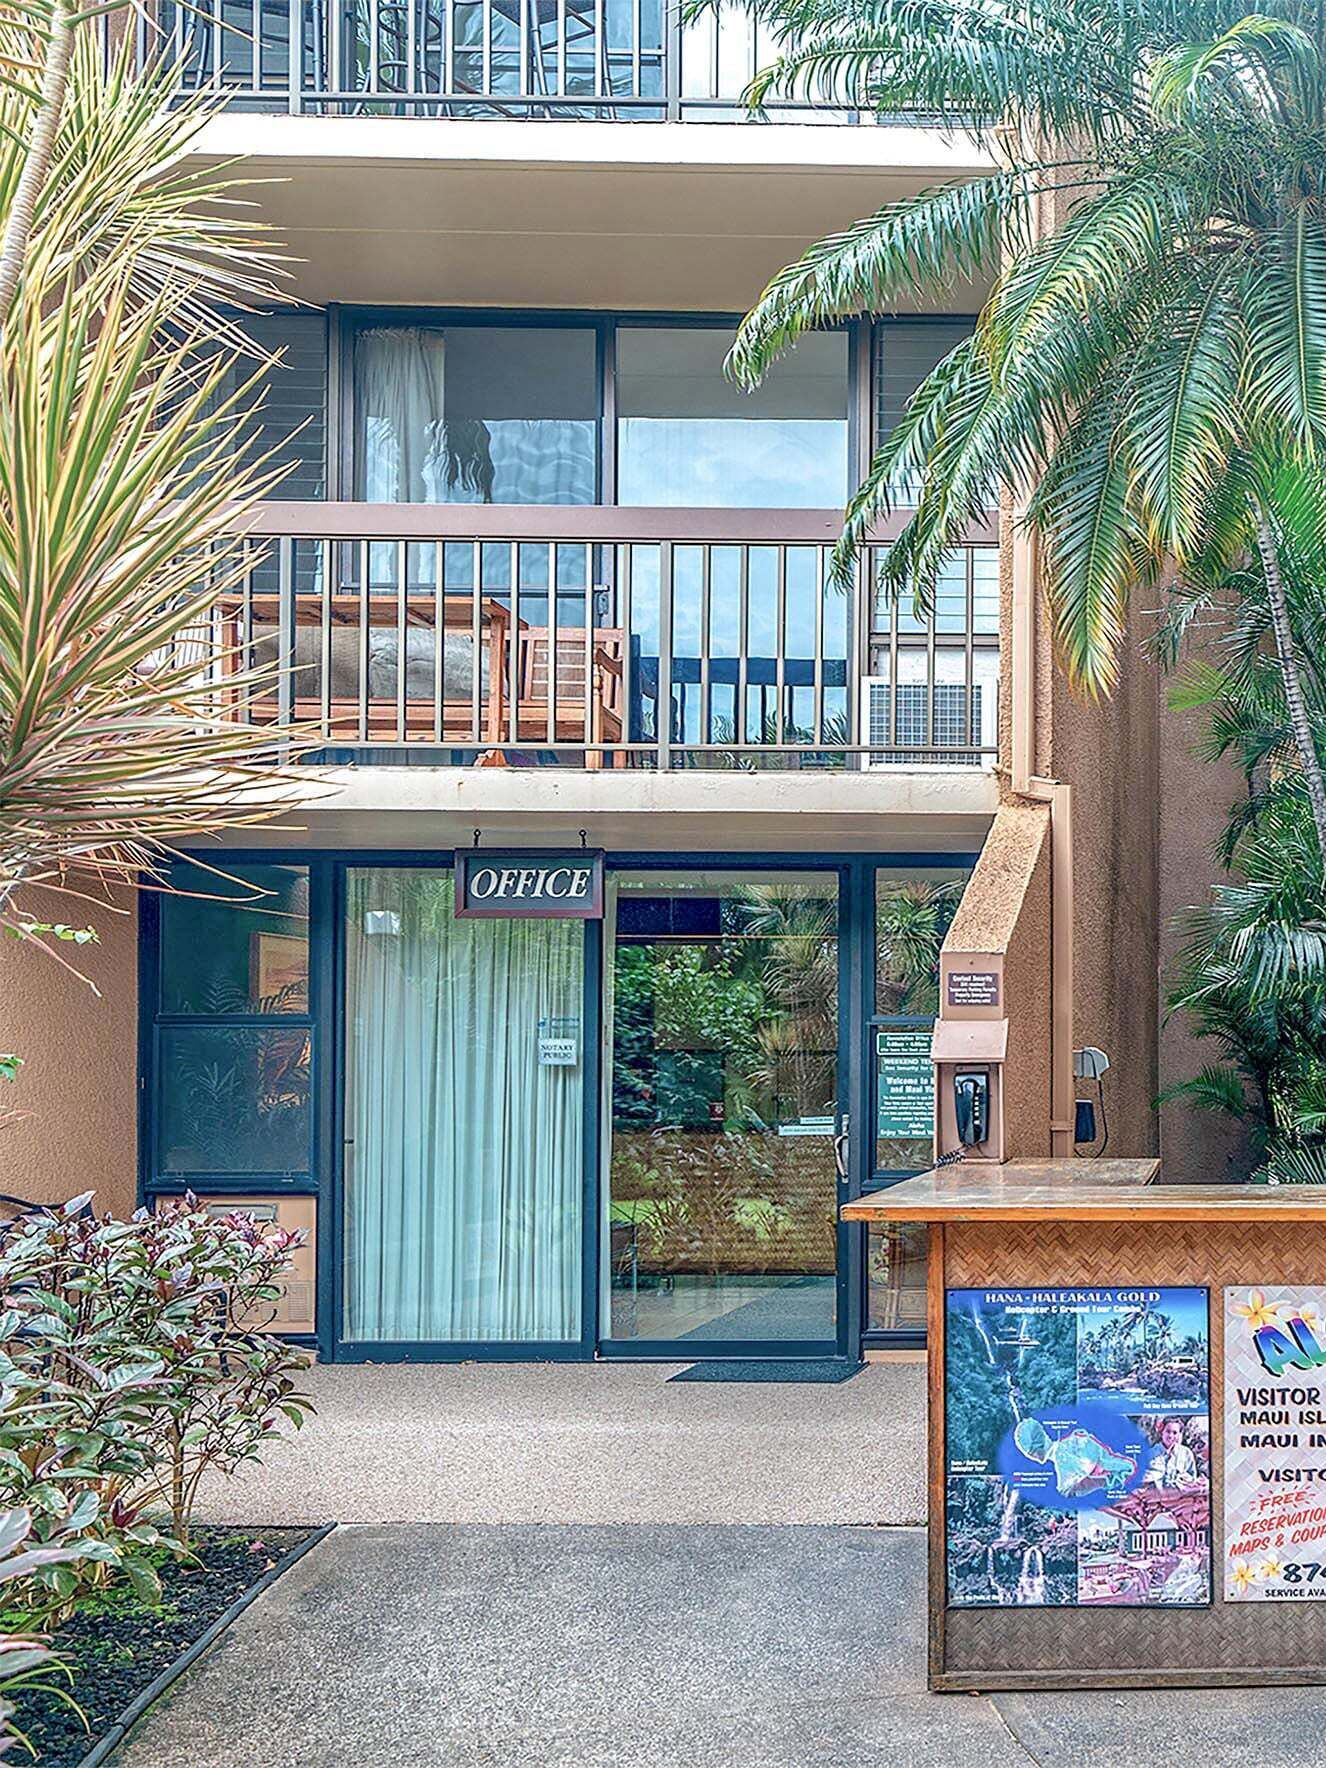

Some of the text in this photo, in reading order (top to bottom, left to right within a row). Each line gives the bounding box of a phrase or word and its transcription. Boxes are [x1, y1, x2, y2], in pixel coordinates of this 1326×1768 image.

[470, 867, 591, 898] OFFICE
[886, 1077, 918, 1085] Welcome
[920, 1077, 929, 1085] to
[985, 1292, 1023, 1303] HANA
[1032, 1292, 1112, 1303] HALEAKALA
[1116, 1291, 1161, 1302] GOLD
[1236, 1387, 1320, 1406] VISITOR
[1240, 1410, 1289, 1425] MAUI
[1240, 1434, 1298, 1448] MAUI
[1260, 1491, 1307, 1511] FREE
[1229, 1536, 1270, 1557] MAPS
[1275, 1533, 1285, 1547] &
[1265, 1588, 1305, 1598] SERVICE
